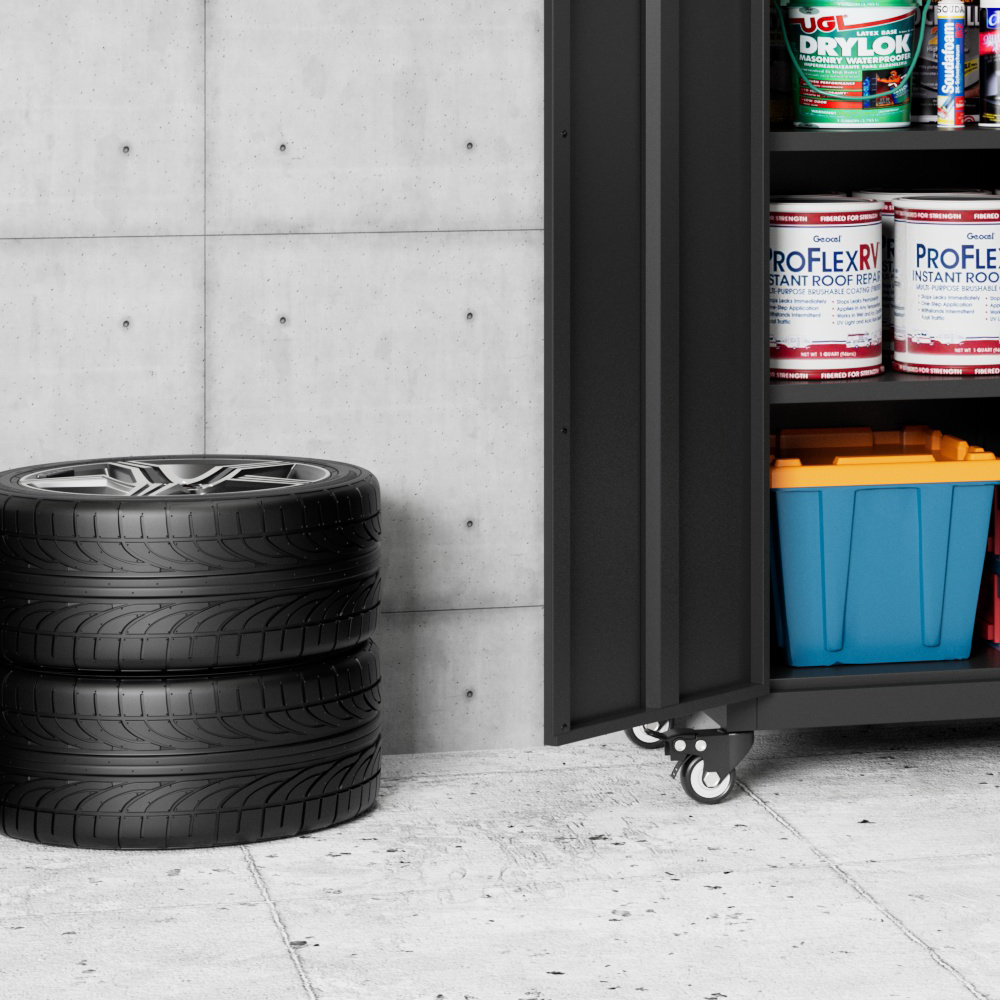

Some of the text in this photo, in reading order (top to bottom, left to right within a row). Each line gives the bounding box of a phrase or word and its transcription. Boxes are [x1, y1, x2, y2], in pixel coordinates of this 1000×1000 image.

[800, 15, 851, 34] UGL
[856, 29, 879, 37] LATEX
[881, 28, 898, 36] BASE
[799, 34, 911, 57] DRYLOK
[799, 53, 912, 65] MASONRY WATERPROOFER
[941, 22, 955, 94] Soudafoam
[847, 214, 860, 222] FOR
[929, 212, 962, 220] STRENGTH
[973, 212, 1000, 220] FIBERED
[813, 235, 841, 243] Geocel
[769, 273, 808, 287] STANT
[812, 275, 853, 287] ROOF
[912, 269, 962, 283] INSTANT
[846, 286, 870, 294] COATING
[916, 283, 960, 292] MULTI-PURPOSE
[961, 284, 998, 292] BRUSHABLE
[821, 371, 847, 379] FIBERED
[848, 370, 860, 378] FOR
[930, 367, 963, 375] STRENGTH
[974, 367, 1000, 375] FIBERED
